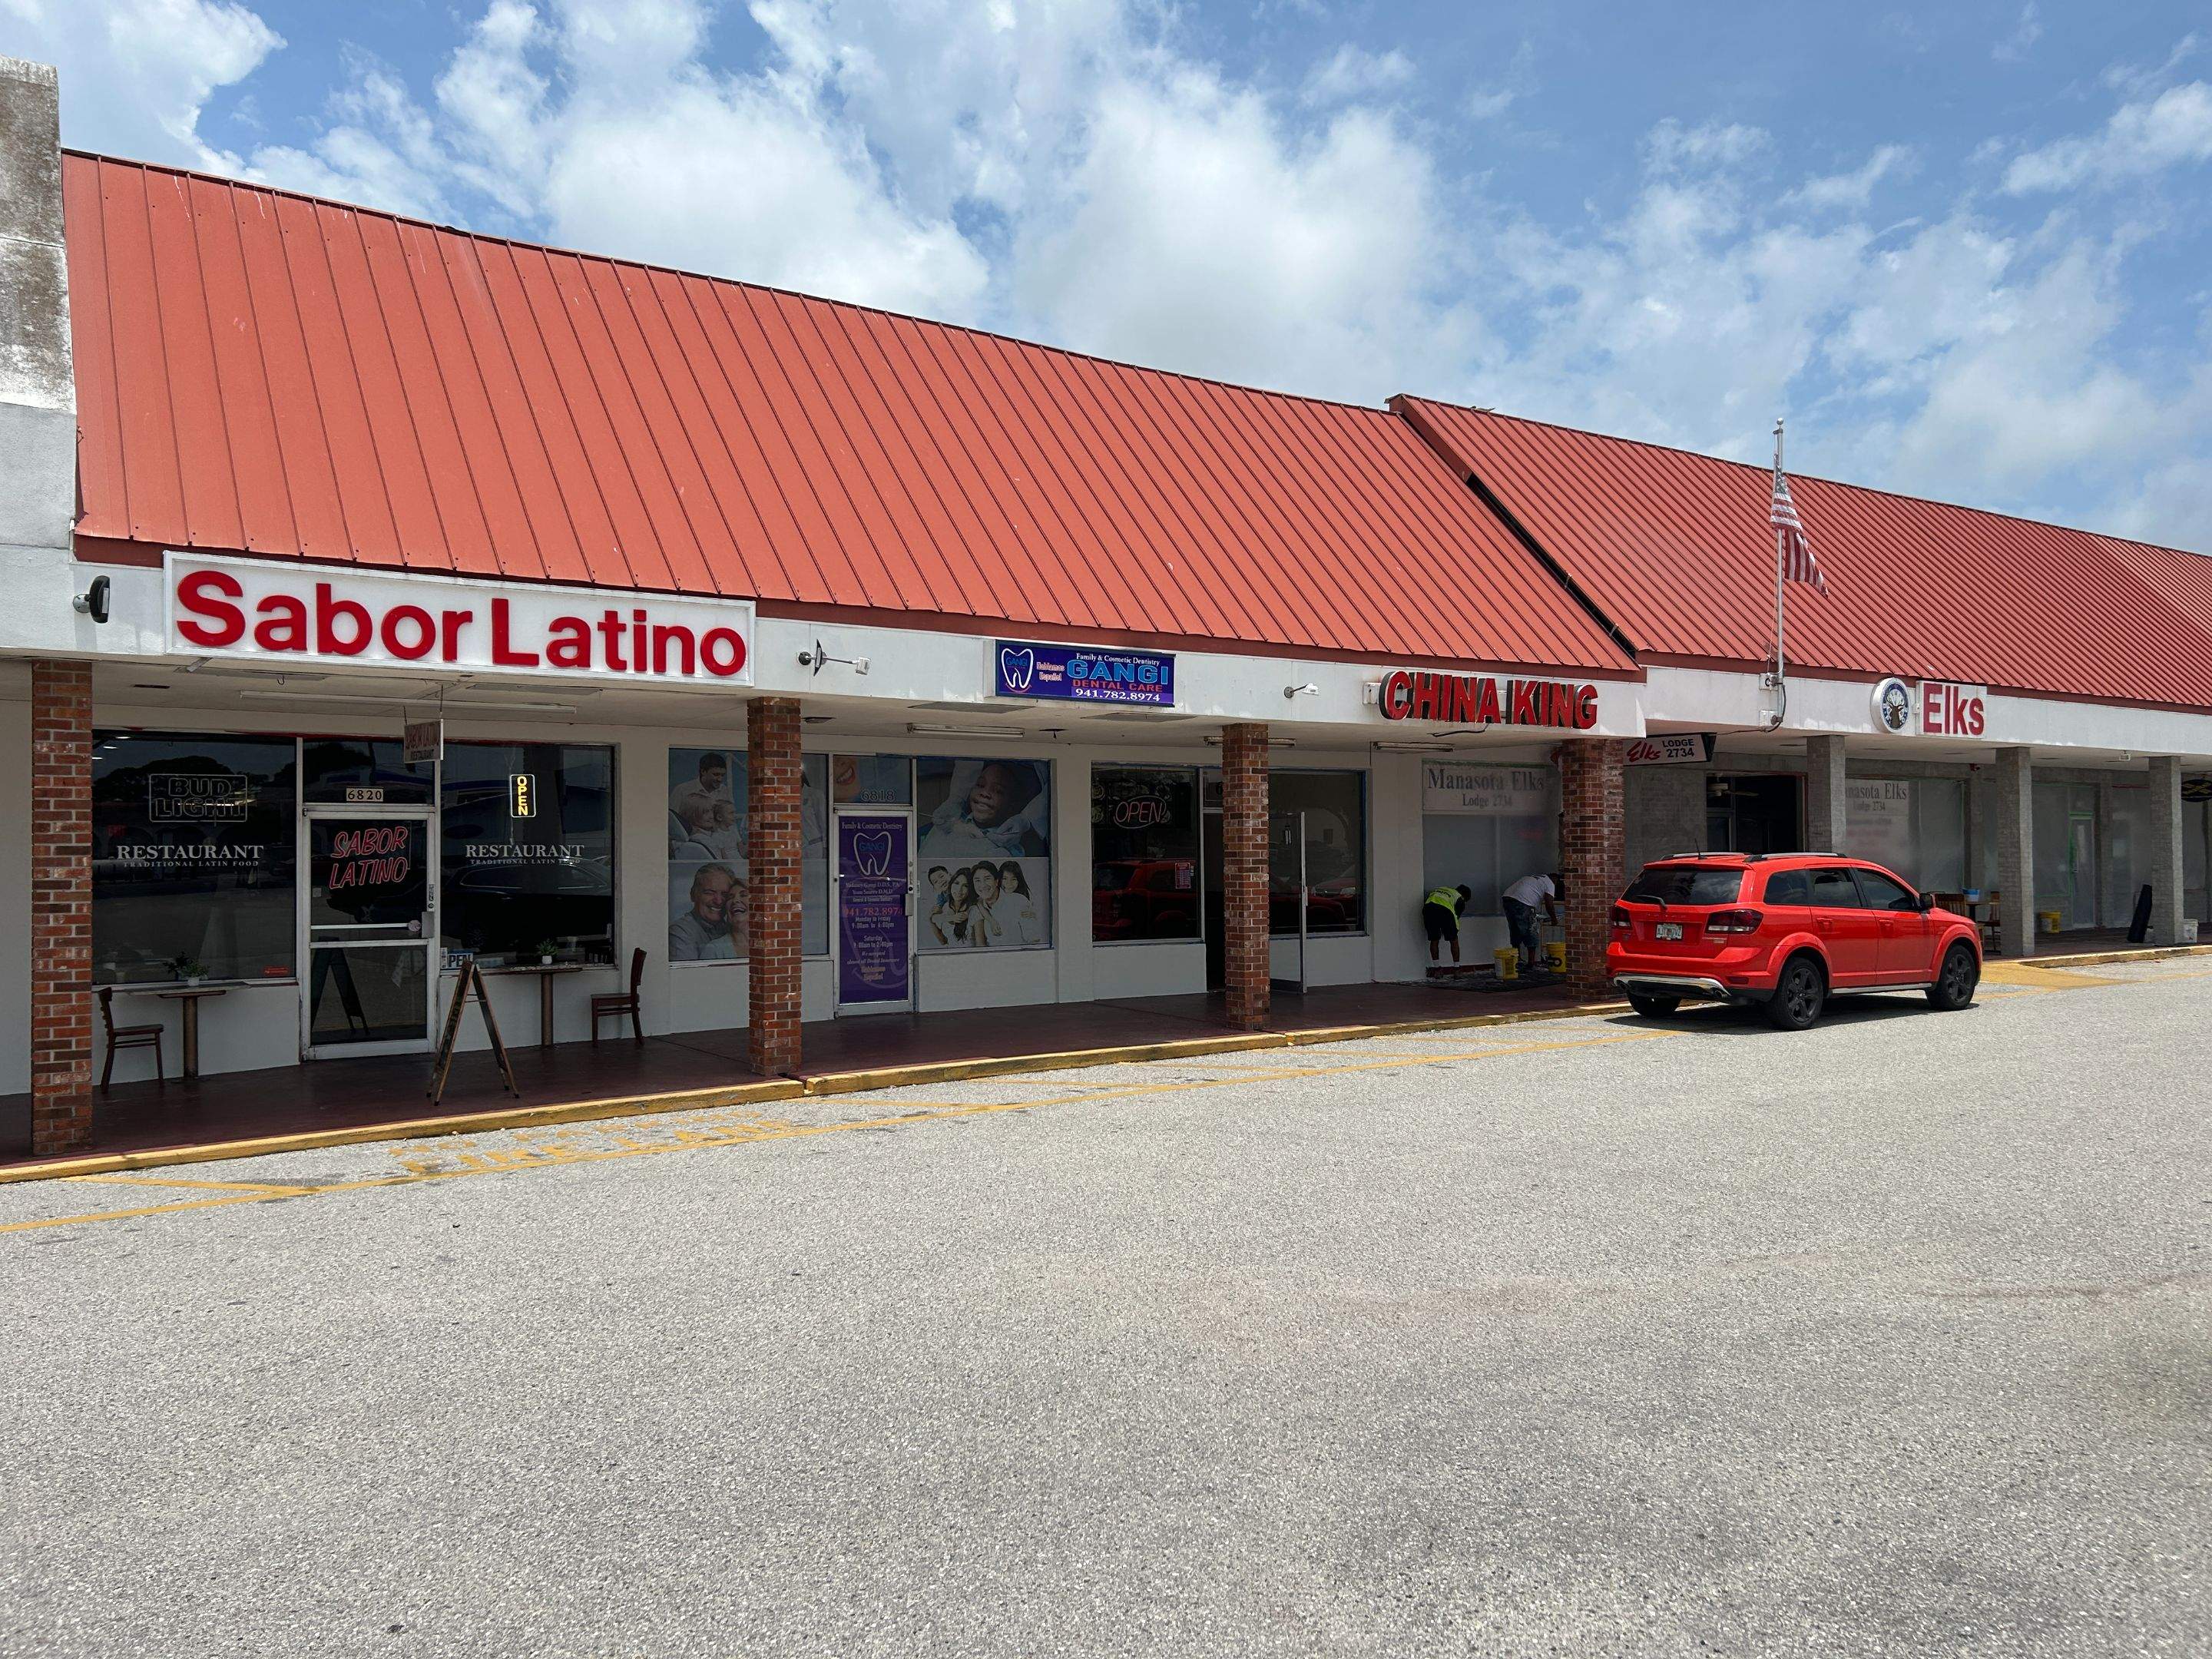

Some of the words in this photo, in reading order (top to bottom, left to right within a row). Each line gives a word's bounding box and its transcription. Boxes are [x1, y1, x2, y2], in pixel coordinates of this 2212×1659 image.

[177, 570, 473, 662] Sabor
[492, 598, 746, 677] Latino
[1006, 657, 1028, 667] GANGI
[1076, 653, 1096, 662] Family
[1104, 655, 1131, 664] Cosmetic
[1133, 657, 1160, 667] Dentistry
[1067, 659, 1168, 685] GANGI
[1072, 679, 1124, 690] DENTAL
[1129, 683, 1163, 692] CARE
[1075, 688, 1161, 701] 941.782.8974
[1379, 671, 1501, 724] CHINA
[1506, 680, 1598, 730] KING
[1923, 683, 1984, 735] Elks
[1627, 740, 1661, 762] Elks
[1667, 747, 1694, 758] 2734
[1662, 738, 1694, 748] LODGE
[168, 778, 232, 797] BUD
[1427, 768, 1505, 790] Manasota
[1511, 771, 1544, 791] Elks
[348, 790, 382, 800] 6820
[517, 776, 528, 816] OPEN
[861, 790, 895, 801] 6818
[1462, 793, 1489, 809] Lodge
[1885, 783, 1907, 800] Elks
[154, 798, 243, 817] LIGHT
[1115, 801, 1162, 823] OPEN
[116, 844, 263, 859] RESTAURANT
[330, 826, 408, 859] SABOR
[465, 844, 584, 858] RESTAURANT
[329, 856, 407, 889] LATINO
